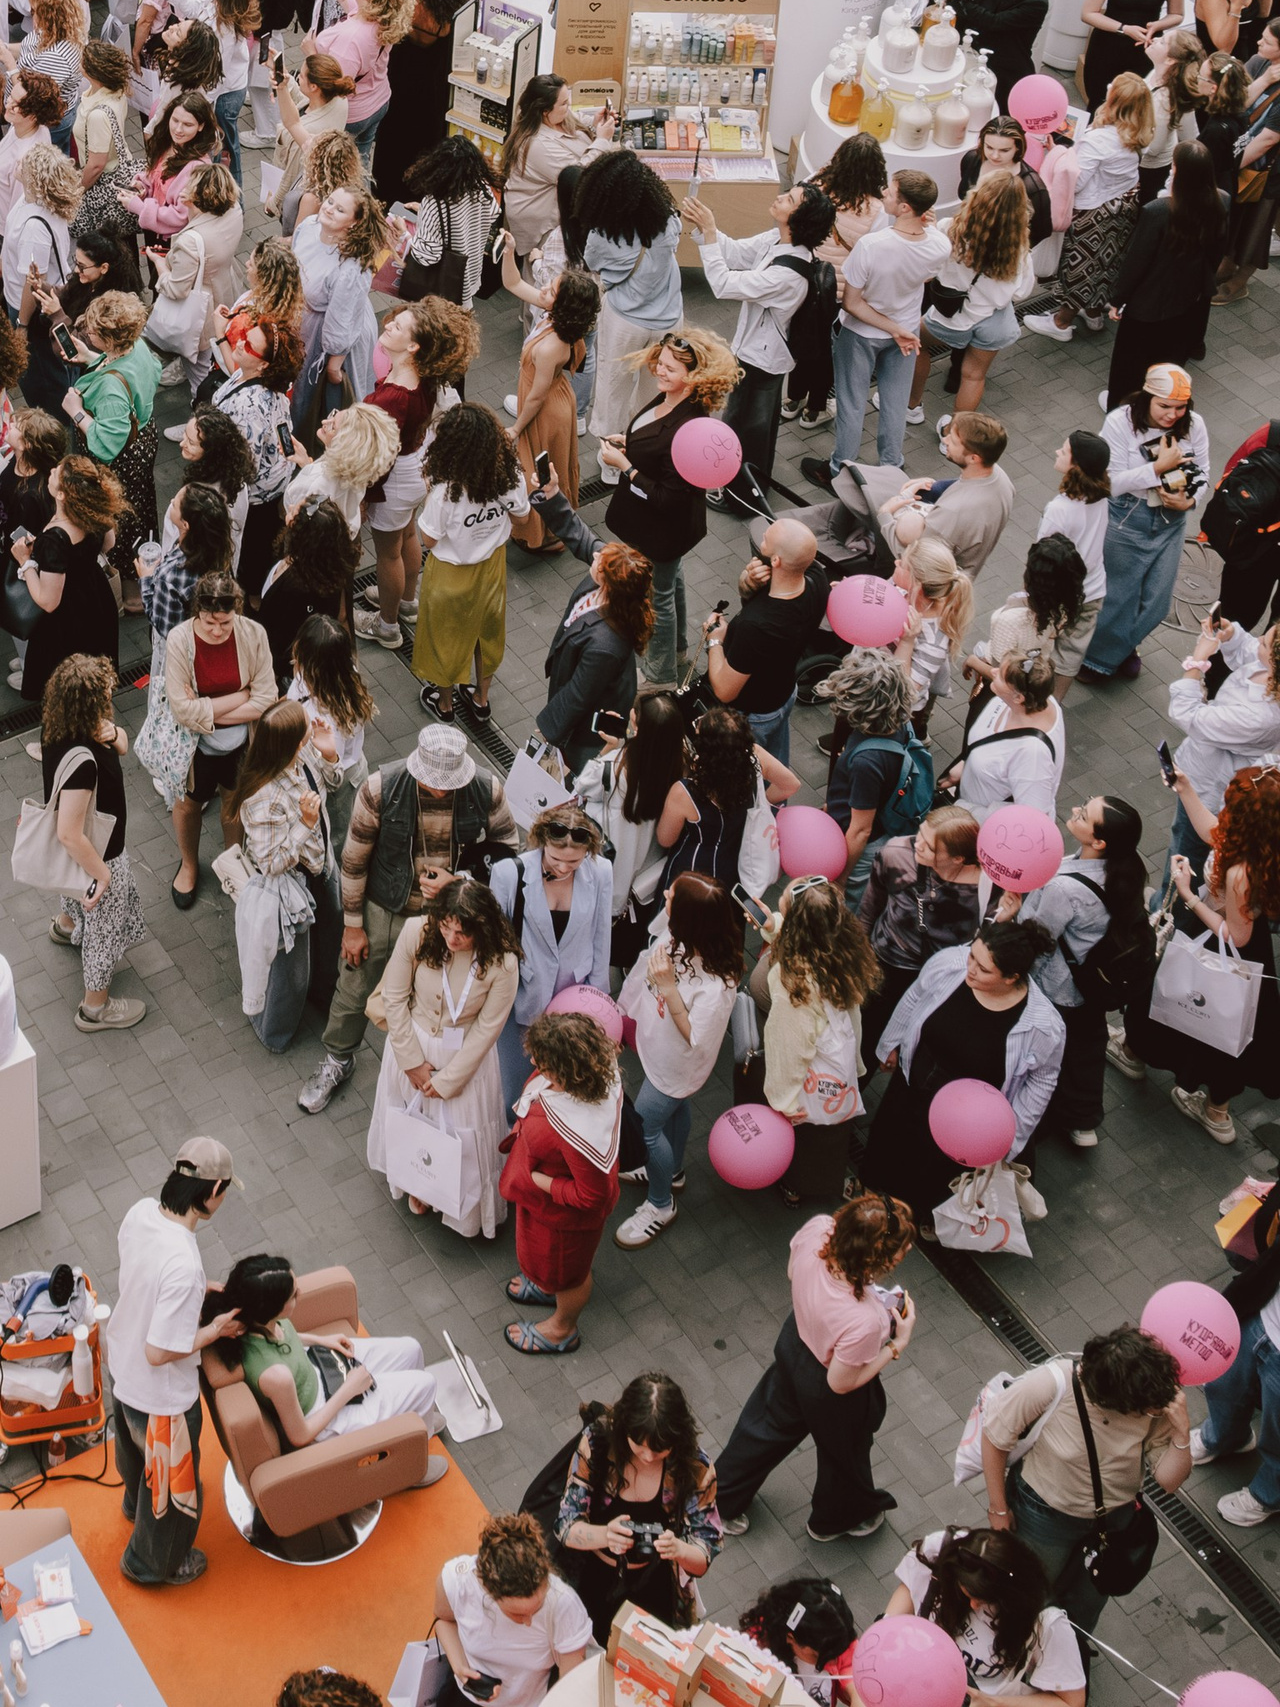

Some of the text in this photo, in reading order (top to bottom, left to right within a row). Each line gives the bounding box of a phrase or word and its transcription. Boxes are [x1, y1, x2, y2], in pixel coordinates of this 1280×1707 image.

[489, 4, 534, 27] somelove
[580, 86, 614, 94] somelove
[702, 433, 734, 469] 28
[875, 583, 887, 606] МЕТОД
[995, 824, 1049, 854] 231
[1179, 1331, 1214, 1361] МЕТОД
[1186, 1318, 1235, 1361] КУДРЯВЫЙ
